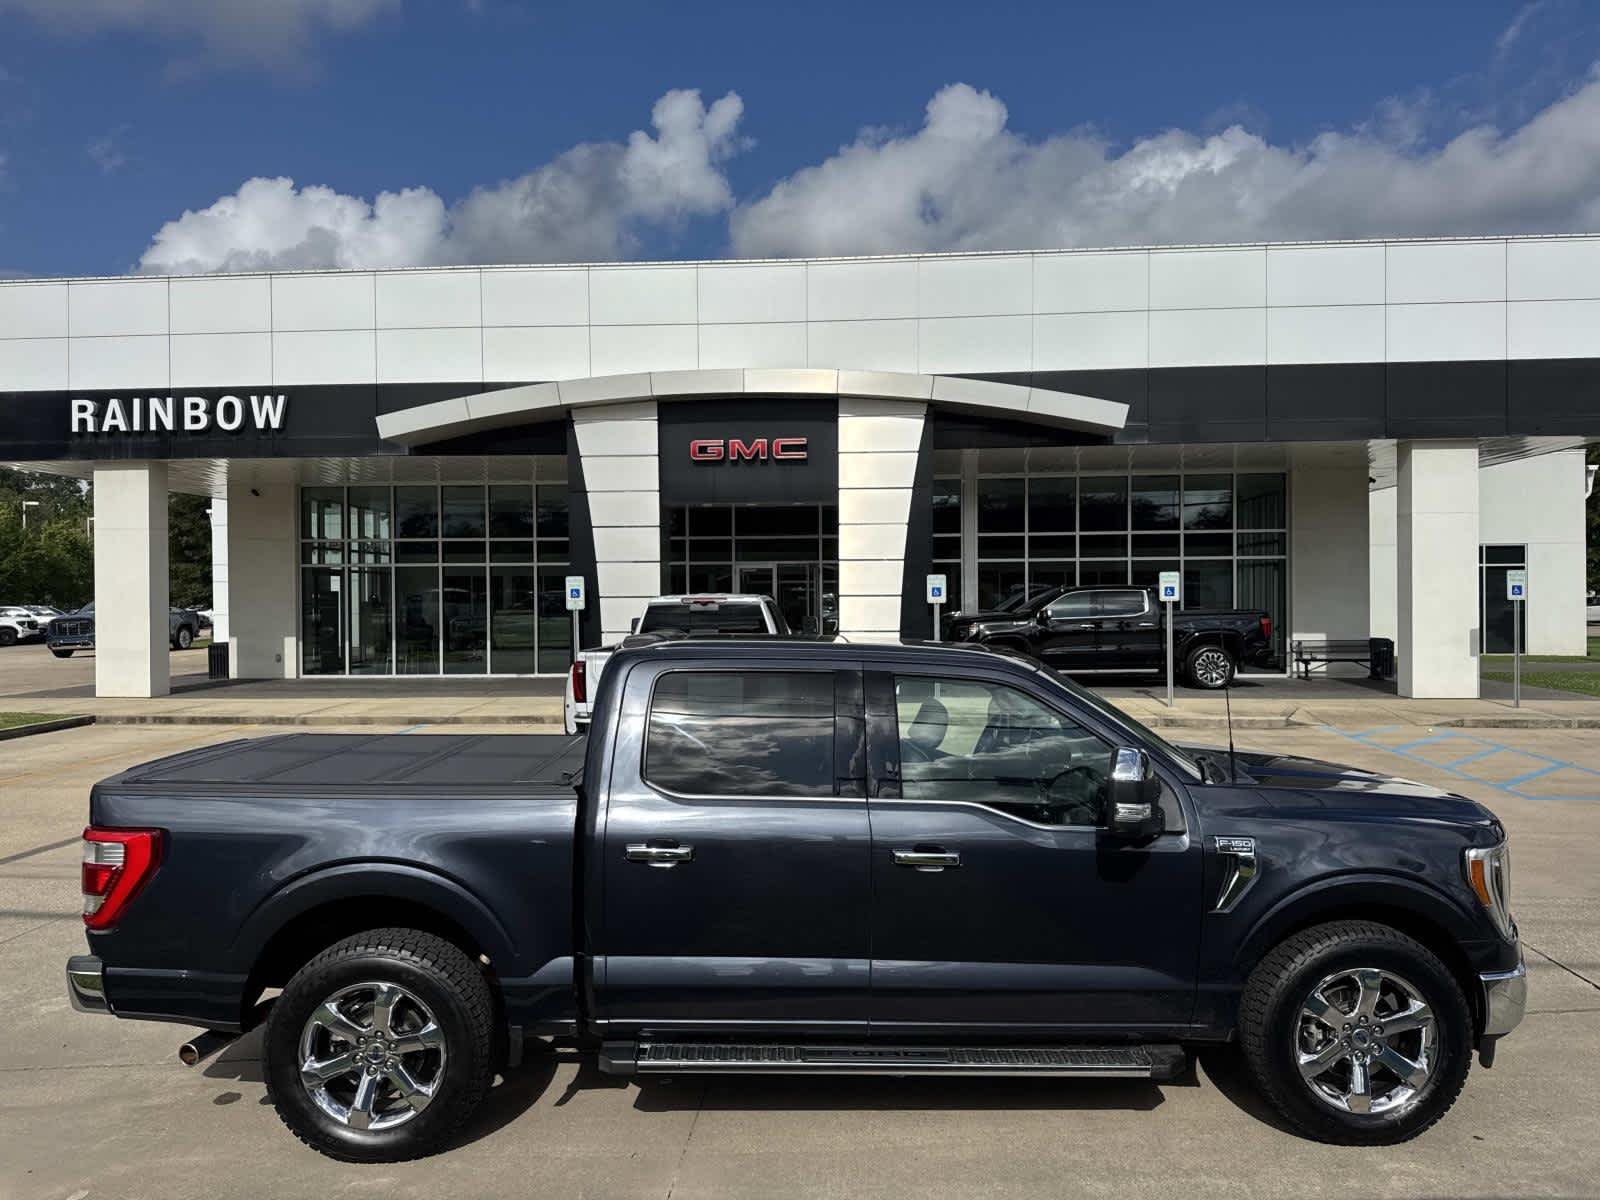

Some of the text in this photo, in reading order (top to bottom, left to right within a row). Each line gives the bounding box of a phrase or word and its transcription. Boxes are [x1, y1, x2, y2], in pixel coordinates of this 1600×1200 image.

[71, 395, 286, 432] RAINBOW
[690, 438, 808, 460] GMC
[1219, 839, 1251, 847] F-150
